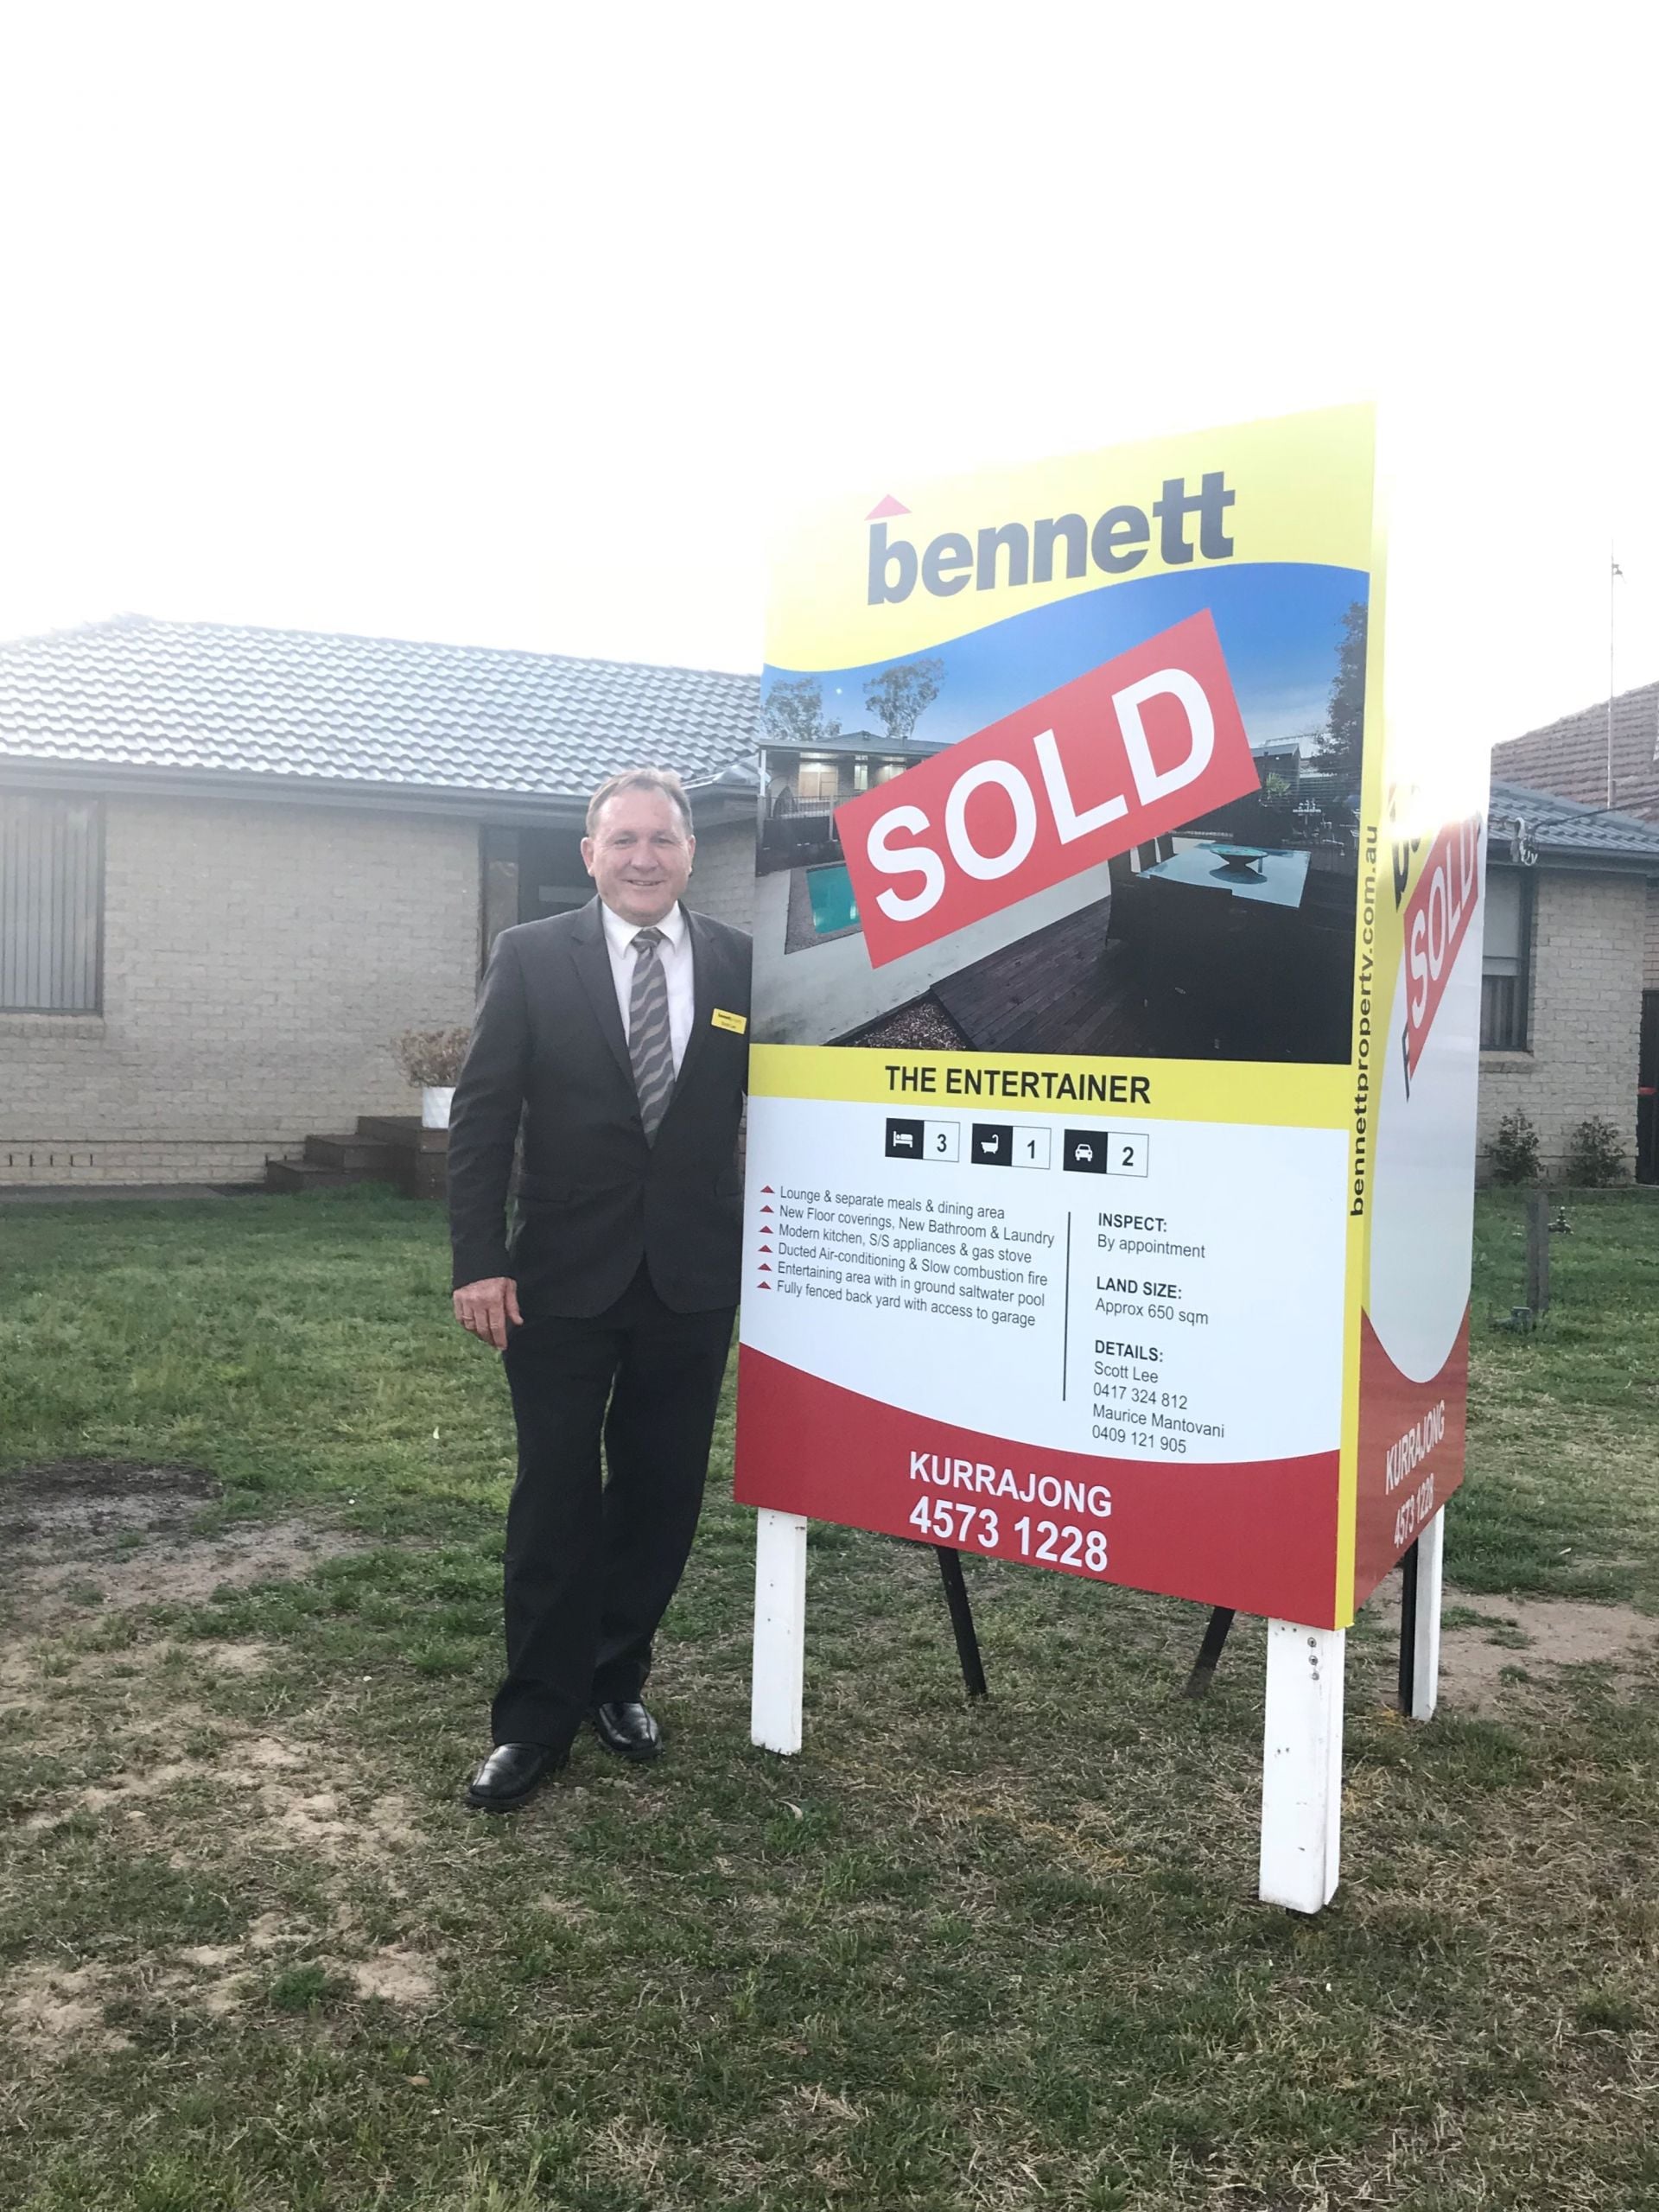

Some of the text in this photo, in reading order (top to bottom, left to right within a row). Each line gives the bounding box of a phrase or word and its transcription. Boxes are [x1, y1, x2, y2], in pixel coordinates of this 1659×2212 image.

[868, 471, 1236, 605] bennett
[867, 668, 1215, 922] SOLD
[1411, 817, 1475, 1028] SOLD
[1350, 825, 1378, 1216] bennettproperty.com.au
[885, 1065, 1151, 1104] THE ENTERTAINER
[937, 1134, 1135, 1166] 3 1 2
[780, 1186, 1005, 1219] Lounge & separate meals & dining area
[1098, 1212, 1167, 1232] INSPECT:
[779, 1205, 1054, 1249] New Floor coverings, New Bathroom & Laundry
[779, 1224, 1032, 1263] Modern kitchen, S/S appliances & gas stove
[1097, 1234, 1205, 1259] By appointment
[778, 1262, 1045, 1306] Entertaining area with in ground saltwater pool
[779, 1243, 1048, 1286] Ducted Air-conditioning & Slow combustion fire
[777, 1280, 1036, 1328] Fully fenced back yard with access to garage
[1096, 1276, 1182, 1299] LAND SIZE:
[1095, 1298, 1209, 1326] Approx 650 sqm
[1095, 1339, 1164, 1362] DETAILS:
[1094, 1361, 1159, 1383] Scott Lee
[1093, 1382, 1188, 1410] 0417 324 812
[1092, 1425, 1187, 1453] 0409 121 905
[1093, 1403, 1225, 1438] Maurice Mantovani
[1385, 1400, 1445, 1496] KURRAJONG
[910, 1451, 1112, 1517] KURRAJONG
[909, 1496, 1108, 1572] 4573 1228
